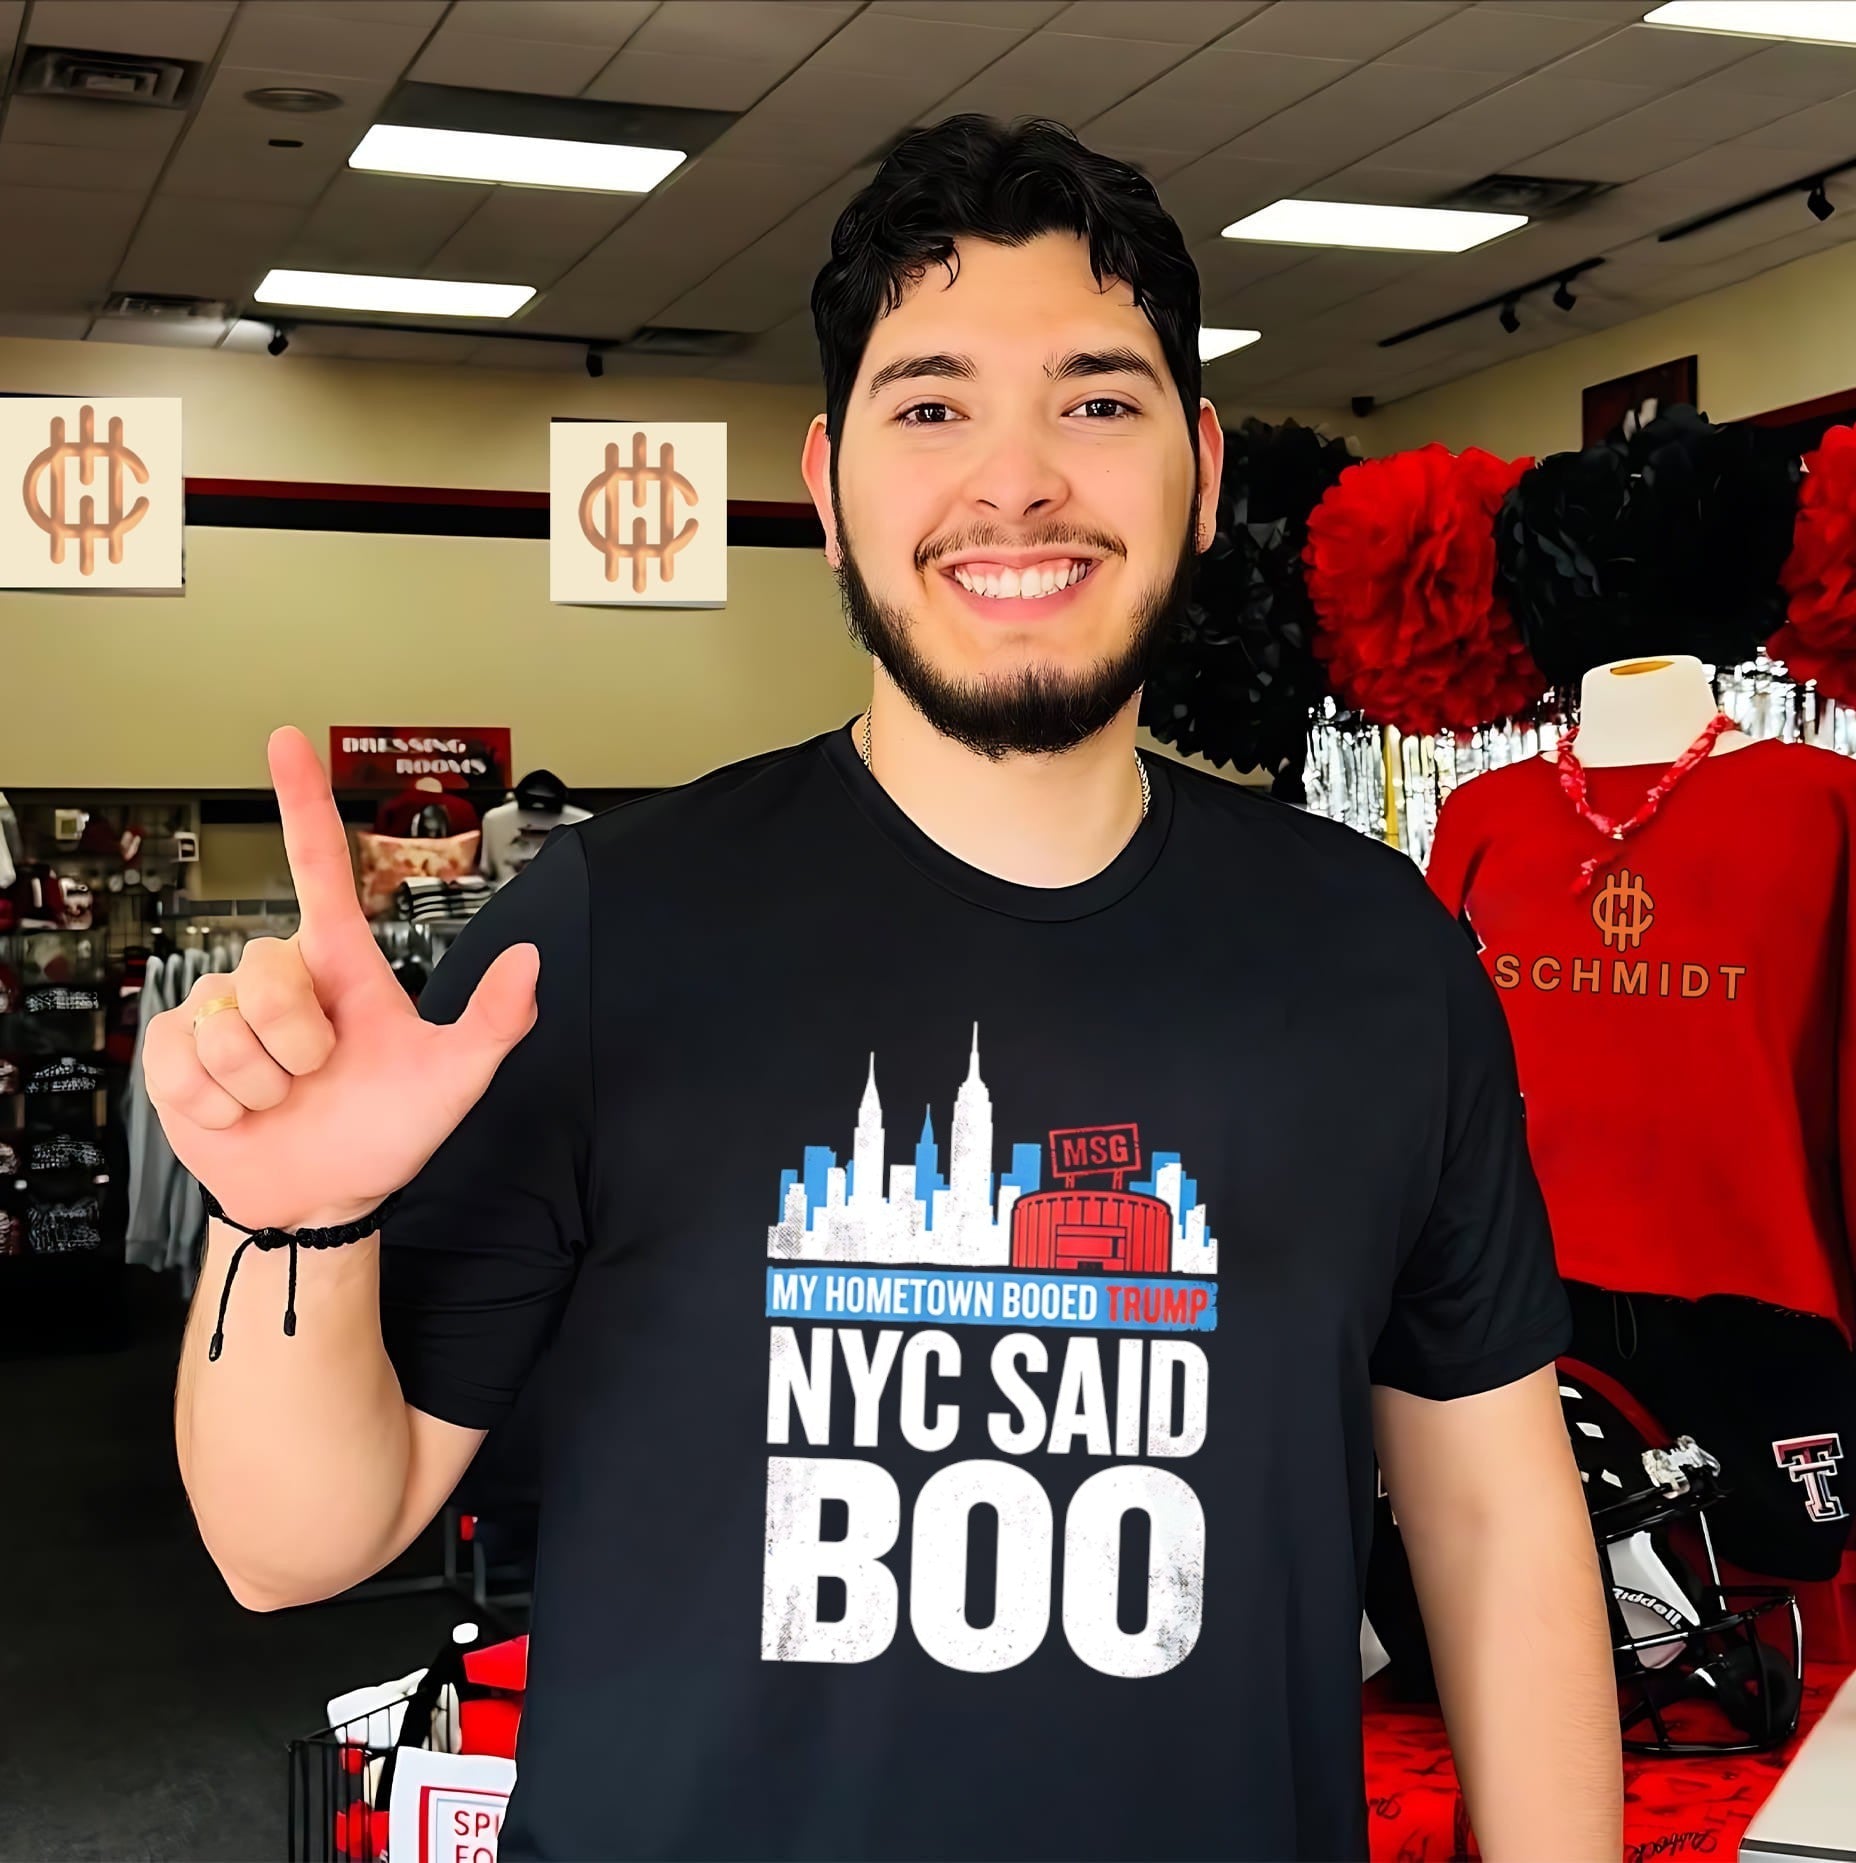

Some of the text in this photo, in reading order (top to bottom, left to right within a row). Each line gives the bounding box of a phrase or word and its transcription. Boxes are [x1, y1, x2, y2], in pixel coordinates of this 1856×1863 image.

[342, 737, 467, 754] DRESSING
[396, 758, 488, 775] ROOMS
[1494, 954, 1746, 1000] SCHMIDT
[1062, 1136, 1129, 1167] MSG
[773, 1273, 1208, 1325] MY HOMETOWN BOOED TRUMP
[766, 1326, 1210, 1458] NYC SAID
[760, 1456, 1207, 1679] BOO
